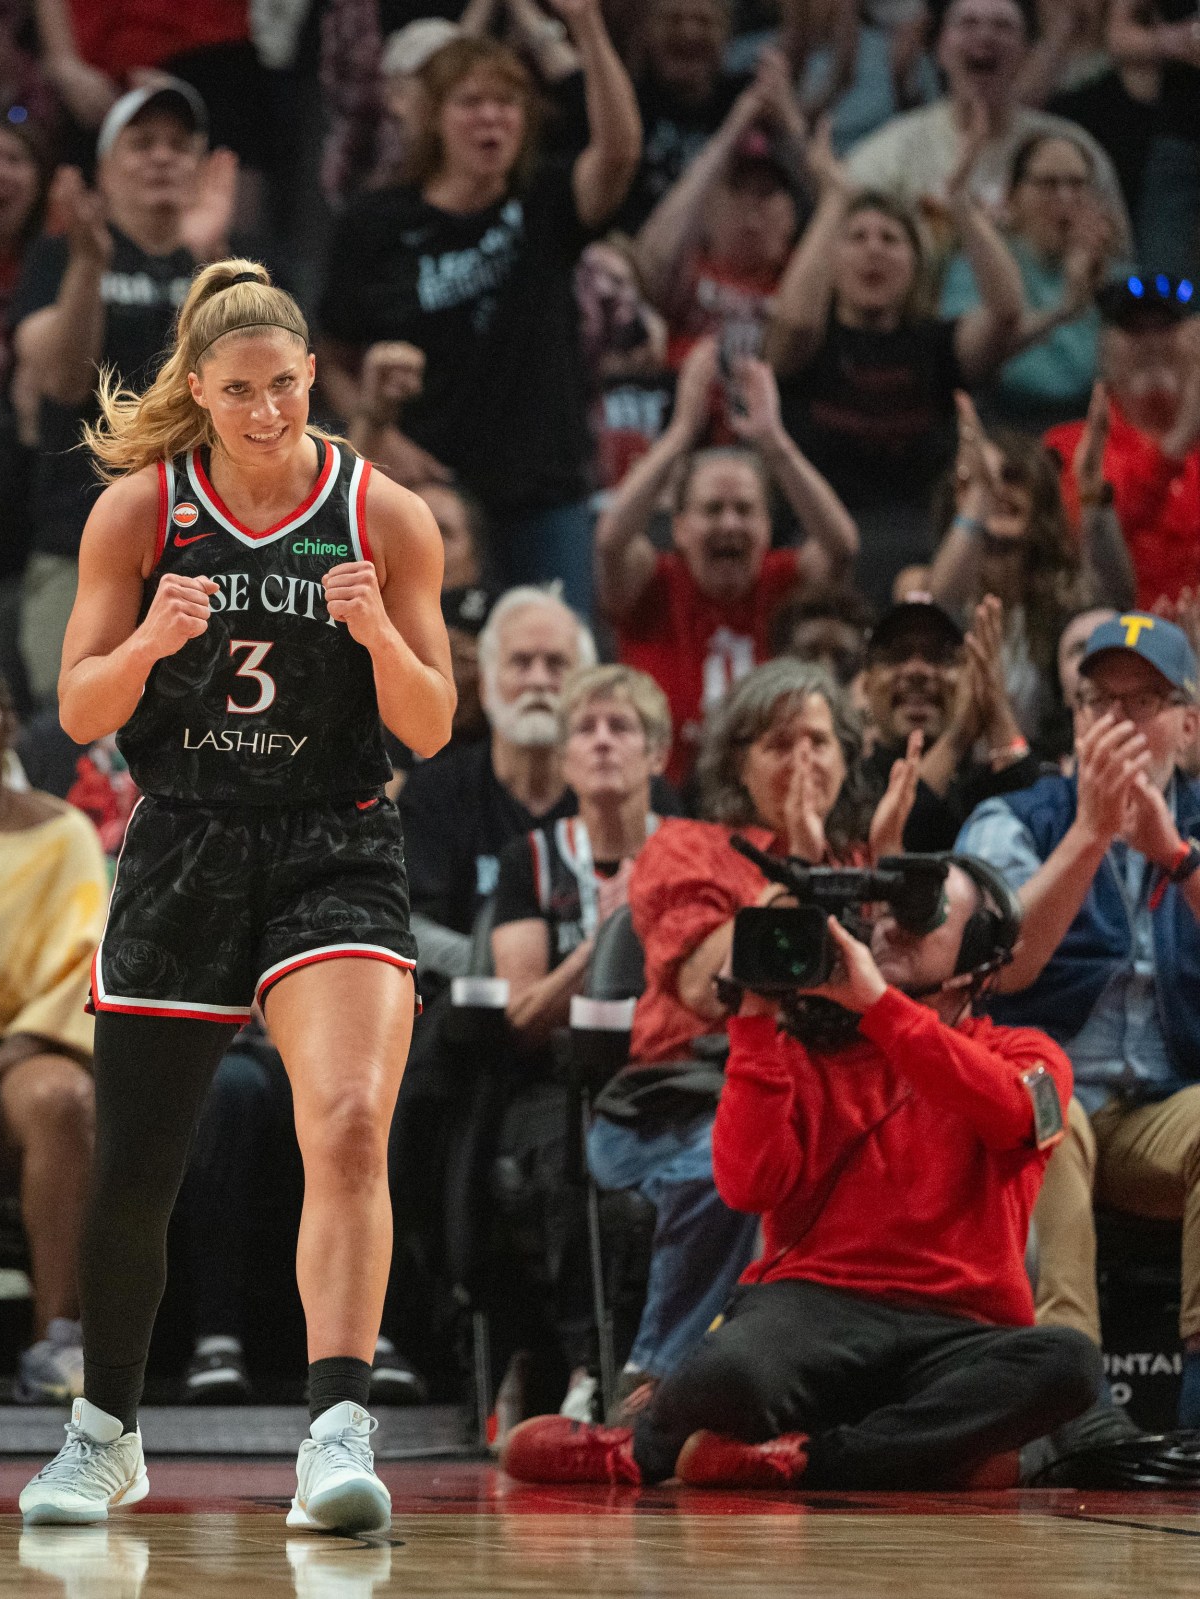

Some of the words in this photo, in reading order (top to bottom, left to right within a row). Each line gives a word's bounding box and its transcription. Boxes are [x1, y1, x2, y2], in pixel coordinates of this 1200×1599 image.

[292, 538, 348, 557] chime
[208, 573, 250, 613] SE
[1120, 615, 1154, 647] T
[226, 639, 277, 715] 3
[183, 728, 307, 755] LASHIFY
